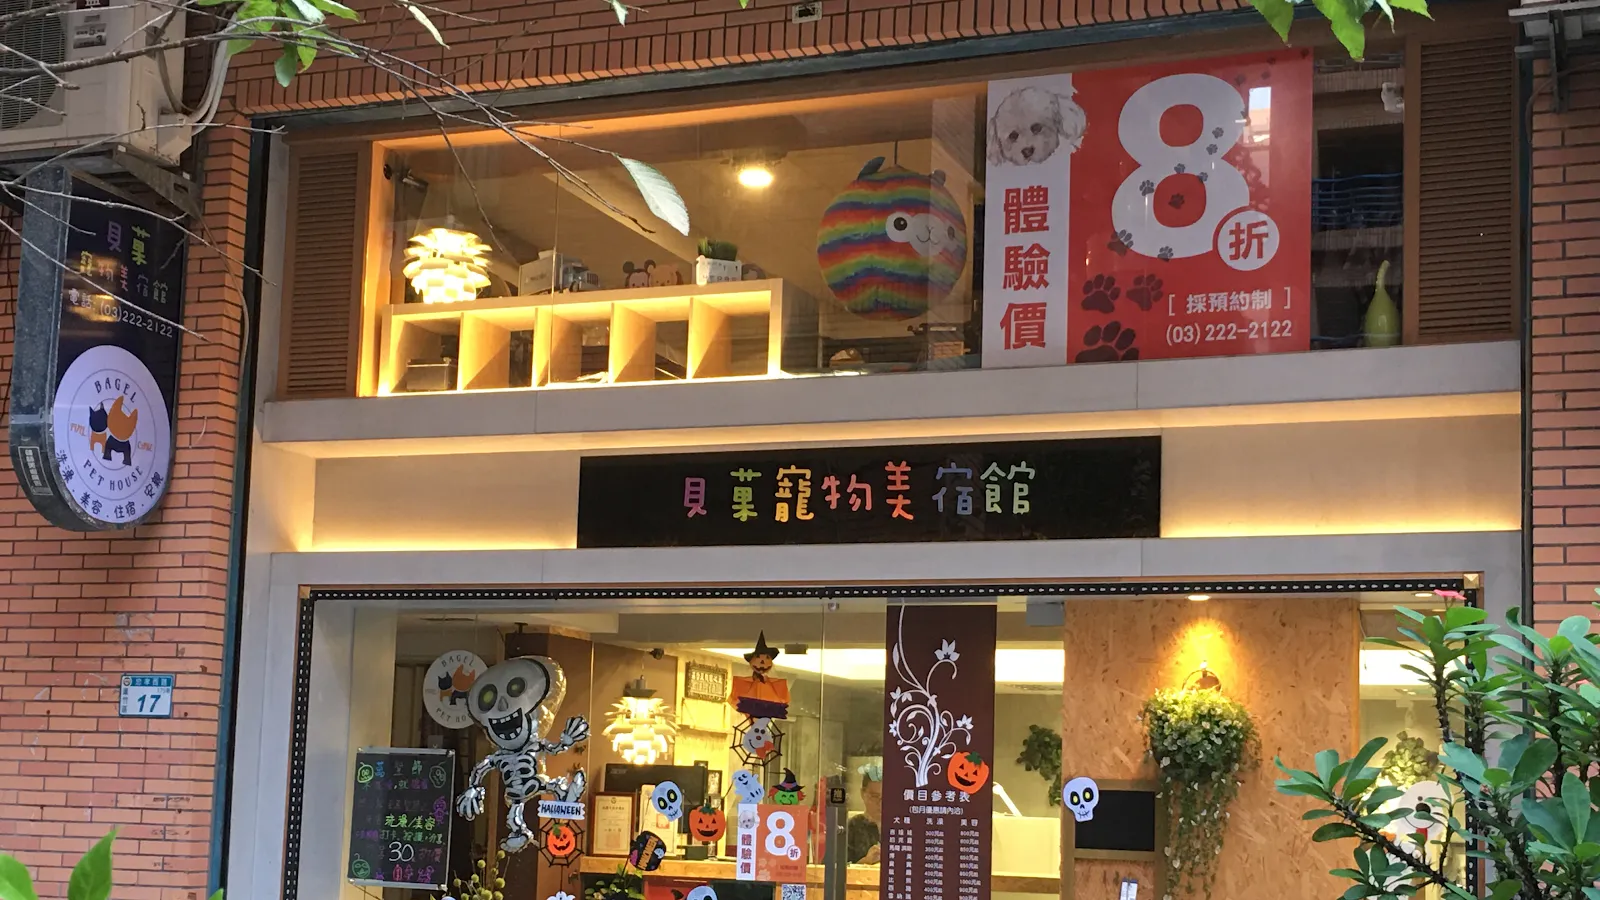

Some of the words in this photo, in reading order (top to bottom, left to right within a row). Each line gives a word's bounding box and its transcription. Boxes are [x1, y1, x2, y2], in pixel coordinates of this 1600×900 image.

[1111, 73, 1250, 259] 8
[107, 220, 151, 265] 貝菓
[1228, 220, 1269, 261] 折
[1000, 185, 1050, 350] 體驗價
[1166, 324, 1201, 345] (03)
[1204, 319, 1292, 342] 222-2122
[93, 376, 138, 404] BAGEL
[83, 458, 105, 487] PET
[109, 465, 144, 492] HOUSE
[683, 459, 1037, 523] 貝菓寵物美宿館
[79, 490, 104, 516] 美容
[113, 500, 137, 520] 住宿
[137, 694, 162, 713] 17
[540, 803, 582, 816] HALLOWEEN
[765, 811, 795, 856] 8
[388, 841, 415, 862] 30
[740, 833, 753, 874] 體驗價
[789, 849, 799, 859] 折
